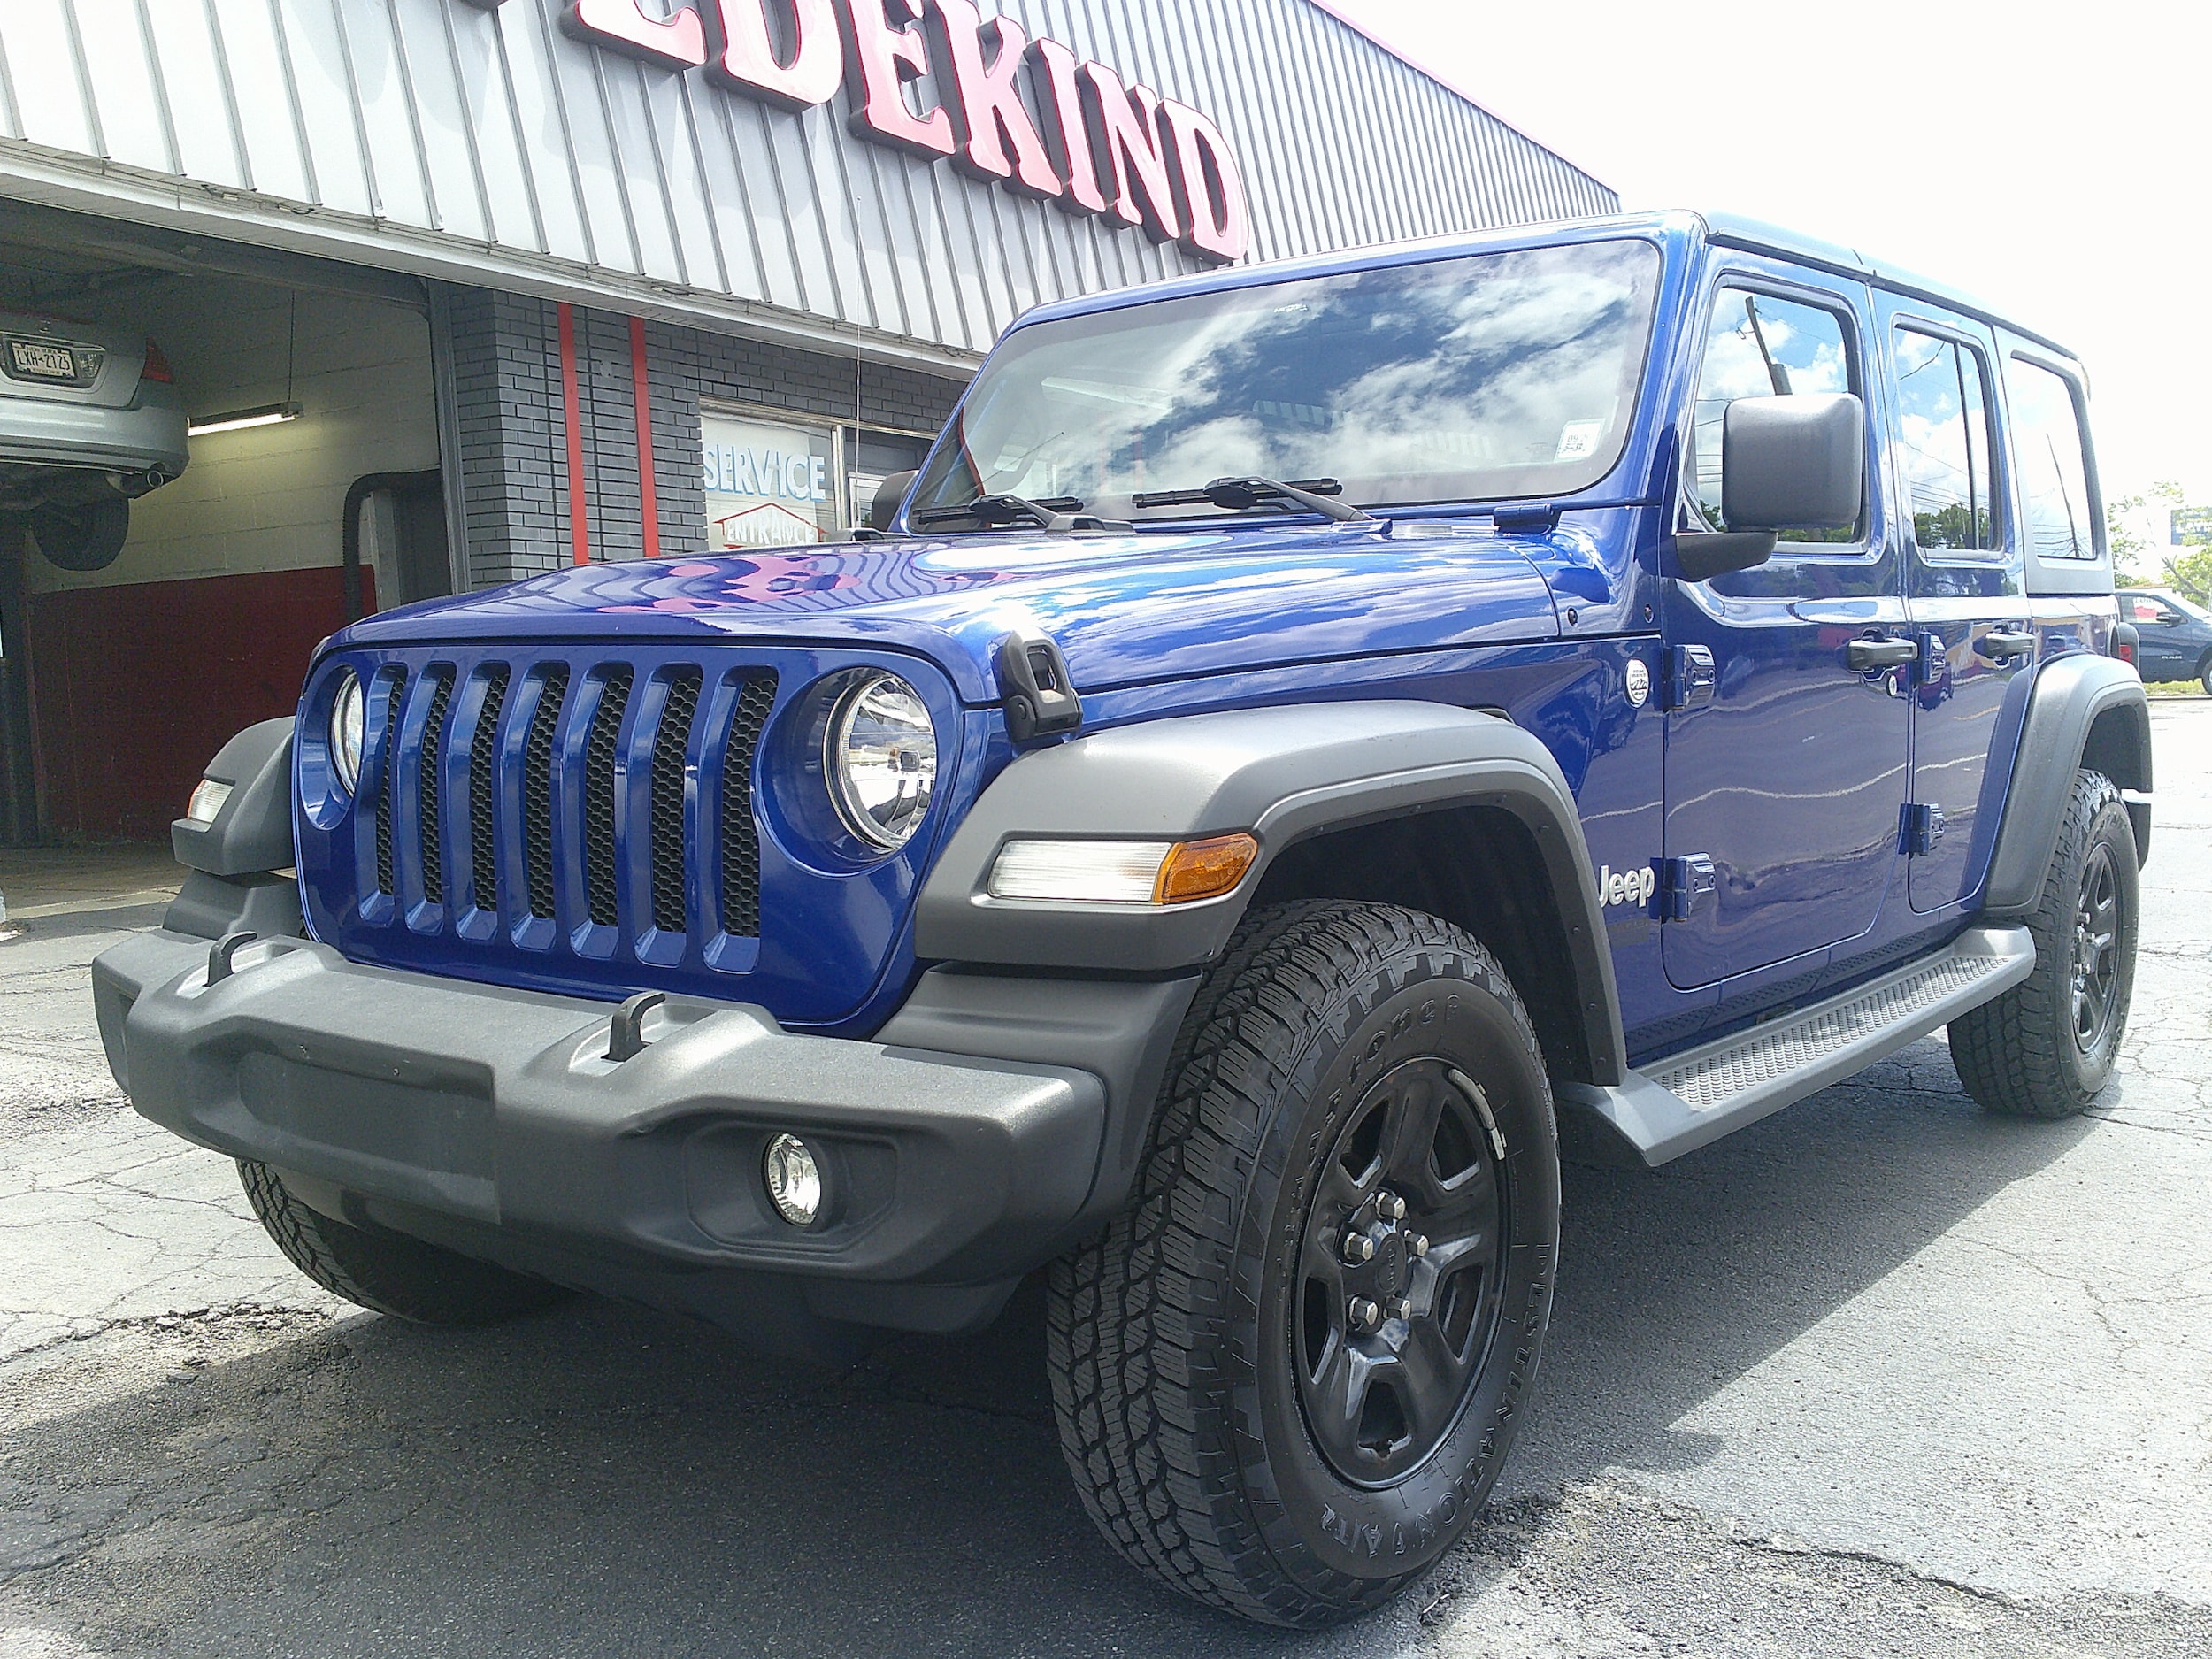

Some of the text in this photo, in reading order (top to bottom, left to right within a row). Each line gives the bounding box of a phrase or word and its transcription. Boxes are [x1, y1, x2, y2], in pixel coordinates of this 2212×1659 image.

[703, 444, 826, 503] SERVICE
[726, 511, 816, 545] ENTRANCE
[1599, 864, 1655, 908] Jeep
